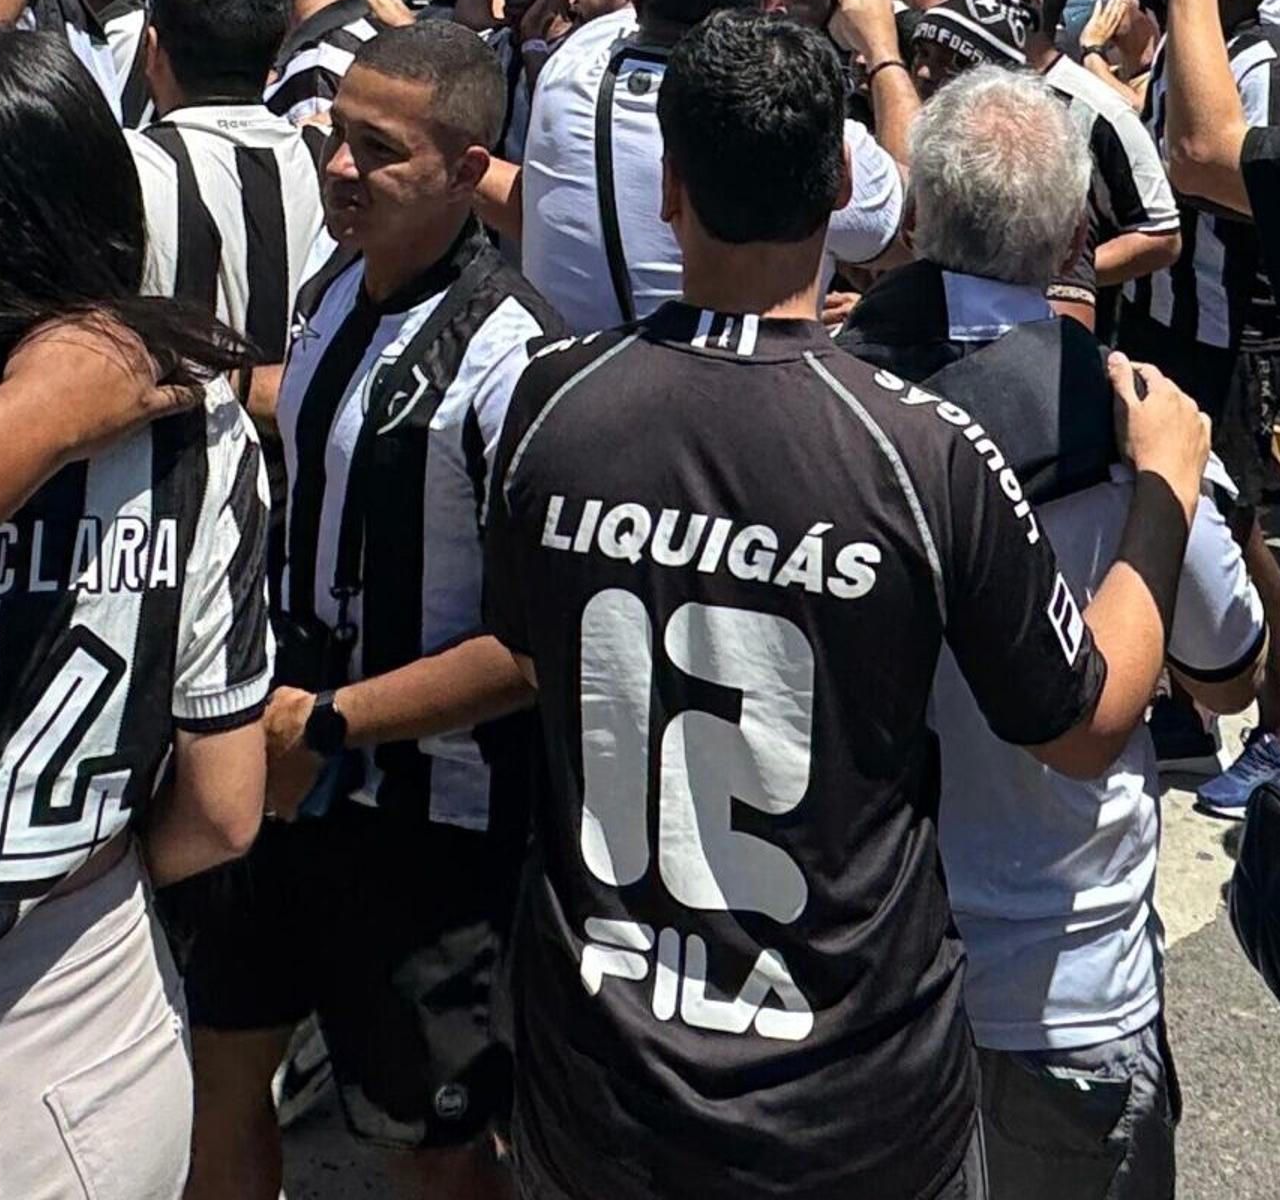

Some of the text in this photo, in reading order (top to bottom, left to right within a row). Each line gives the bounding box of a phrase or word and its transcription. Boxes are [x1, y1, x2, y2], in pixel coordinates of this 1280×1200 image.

[540, 495, 883, 599] LIQUIGÁS
[581, 588, 815, 924] 12
[580, 916, 815, 1042] FILA
